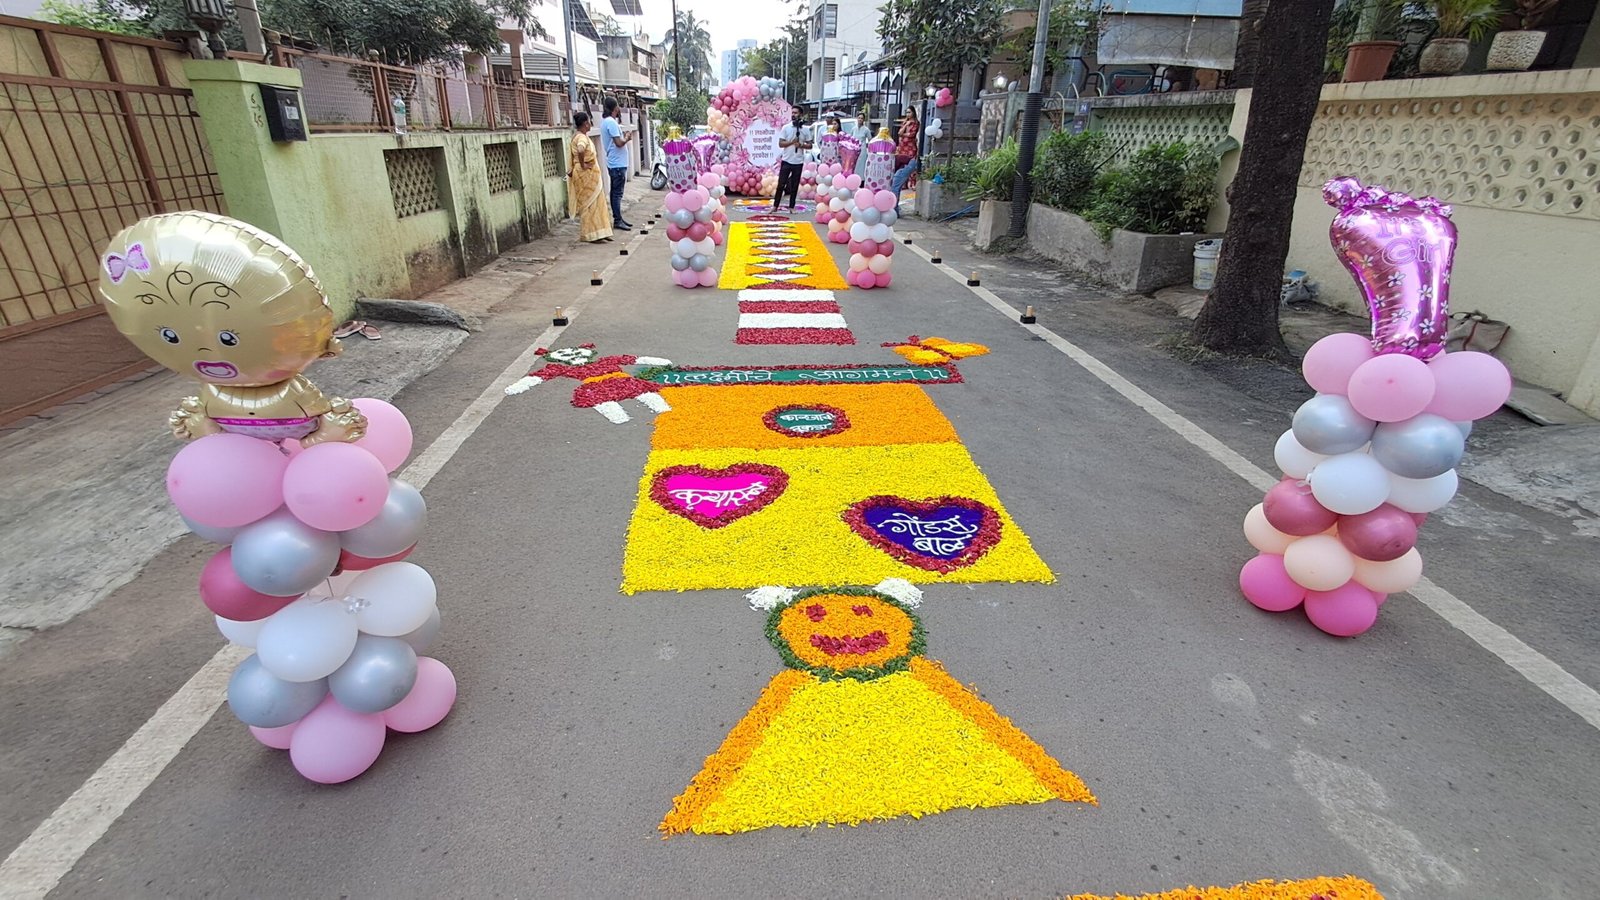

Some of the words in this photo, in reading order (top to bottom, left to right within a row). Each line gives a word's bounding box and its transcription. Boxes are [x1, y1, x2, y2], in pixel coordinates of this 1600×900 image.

[798, 368, 922, 381] आगमन
[877, 512, 979, 537] गोंडस
[912, 533, 973, 556] बाळ
